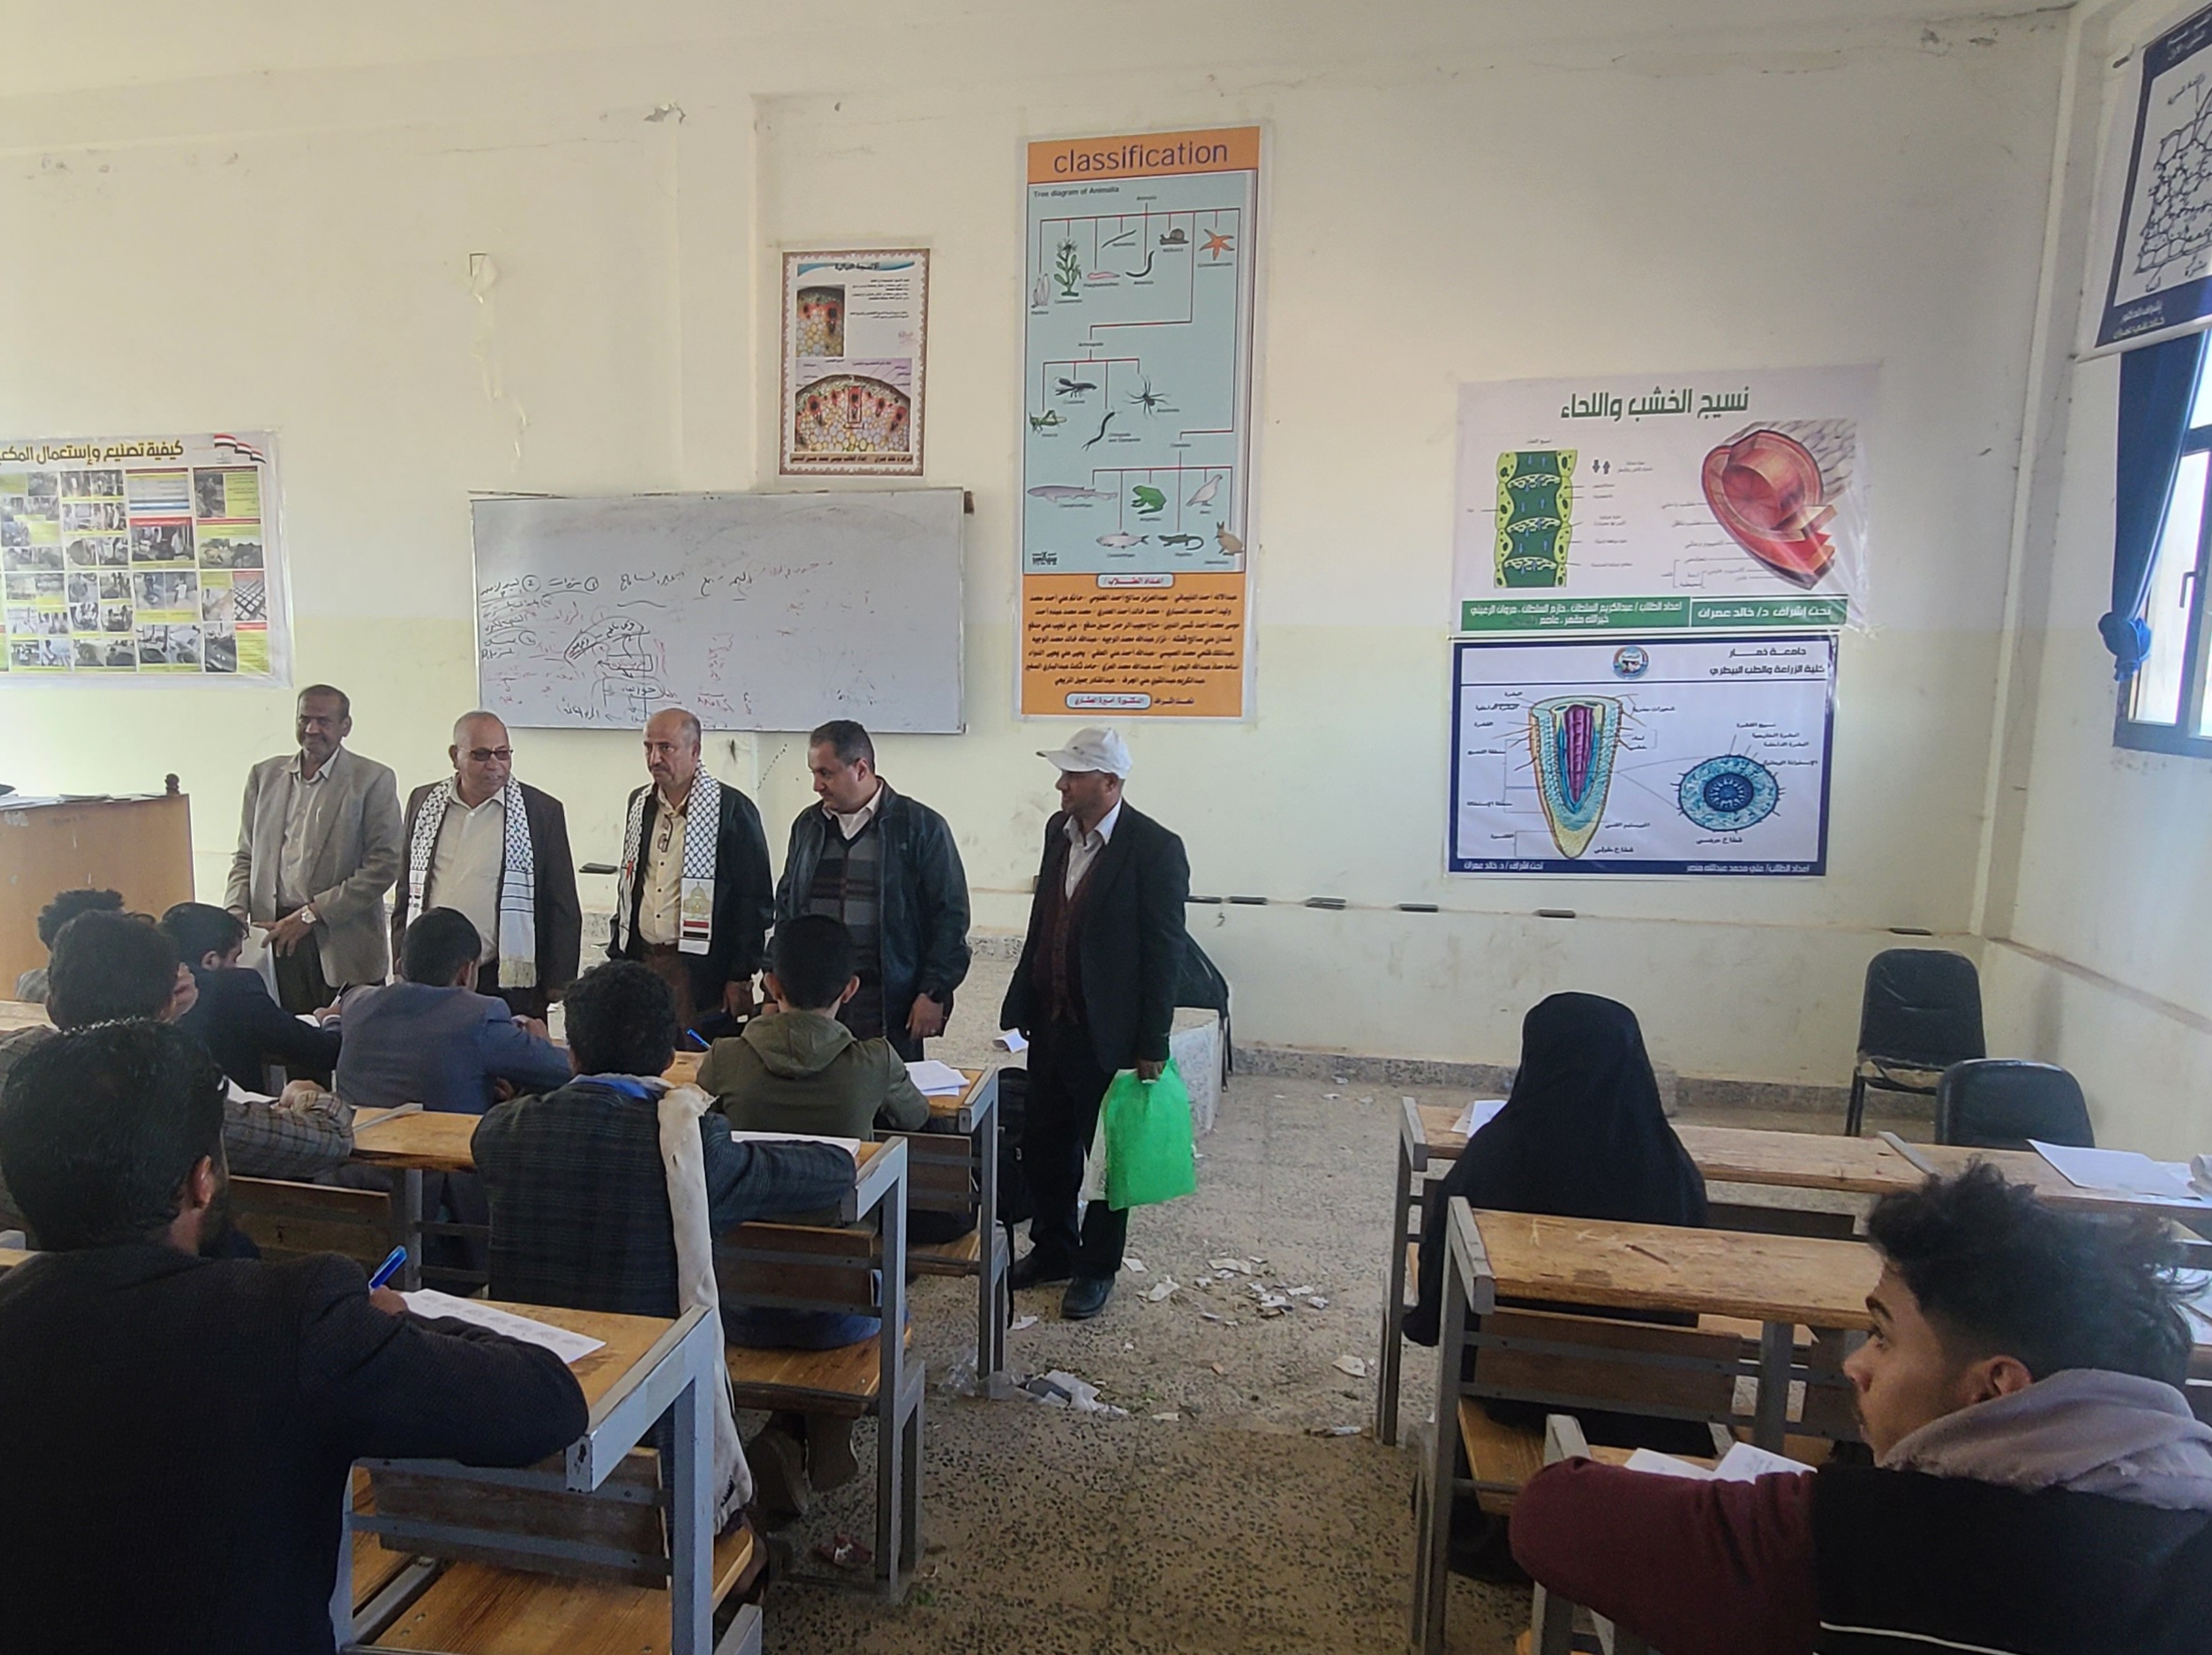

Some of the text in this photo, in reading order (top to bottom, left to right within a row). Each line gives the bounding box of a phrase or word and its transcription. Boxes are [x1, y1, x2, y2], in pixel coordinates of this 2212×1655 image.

[1054, 141, 1228, 173] classification
[1561, 386, 1749, 422] نسيج الخشب واللحاء
[37, 444, 101, 465] وإستعمال
[103, 443, 144, 462] تصنيع
[147, 440, 184, 460] كيفية
[1698, 607, 1731, 619] عمران
[1733, 607, 1755, 617] خالد
[1808, 607, 1831, 616] تحت
[1709, 664, 1825, 676] كلية الزراعة والطب البيطري
